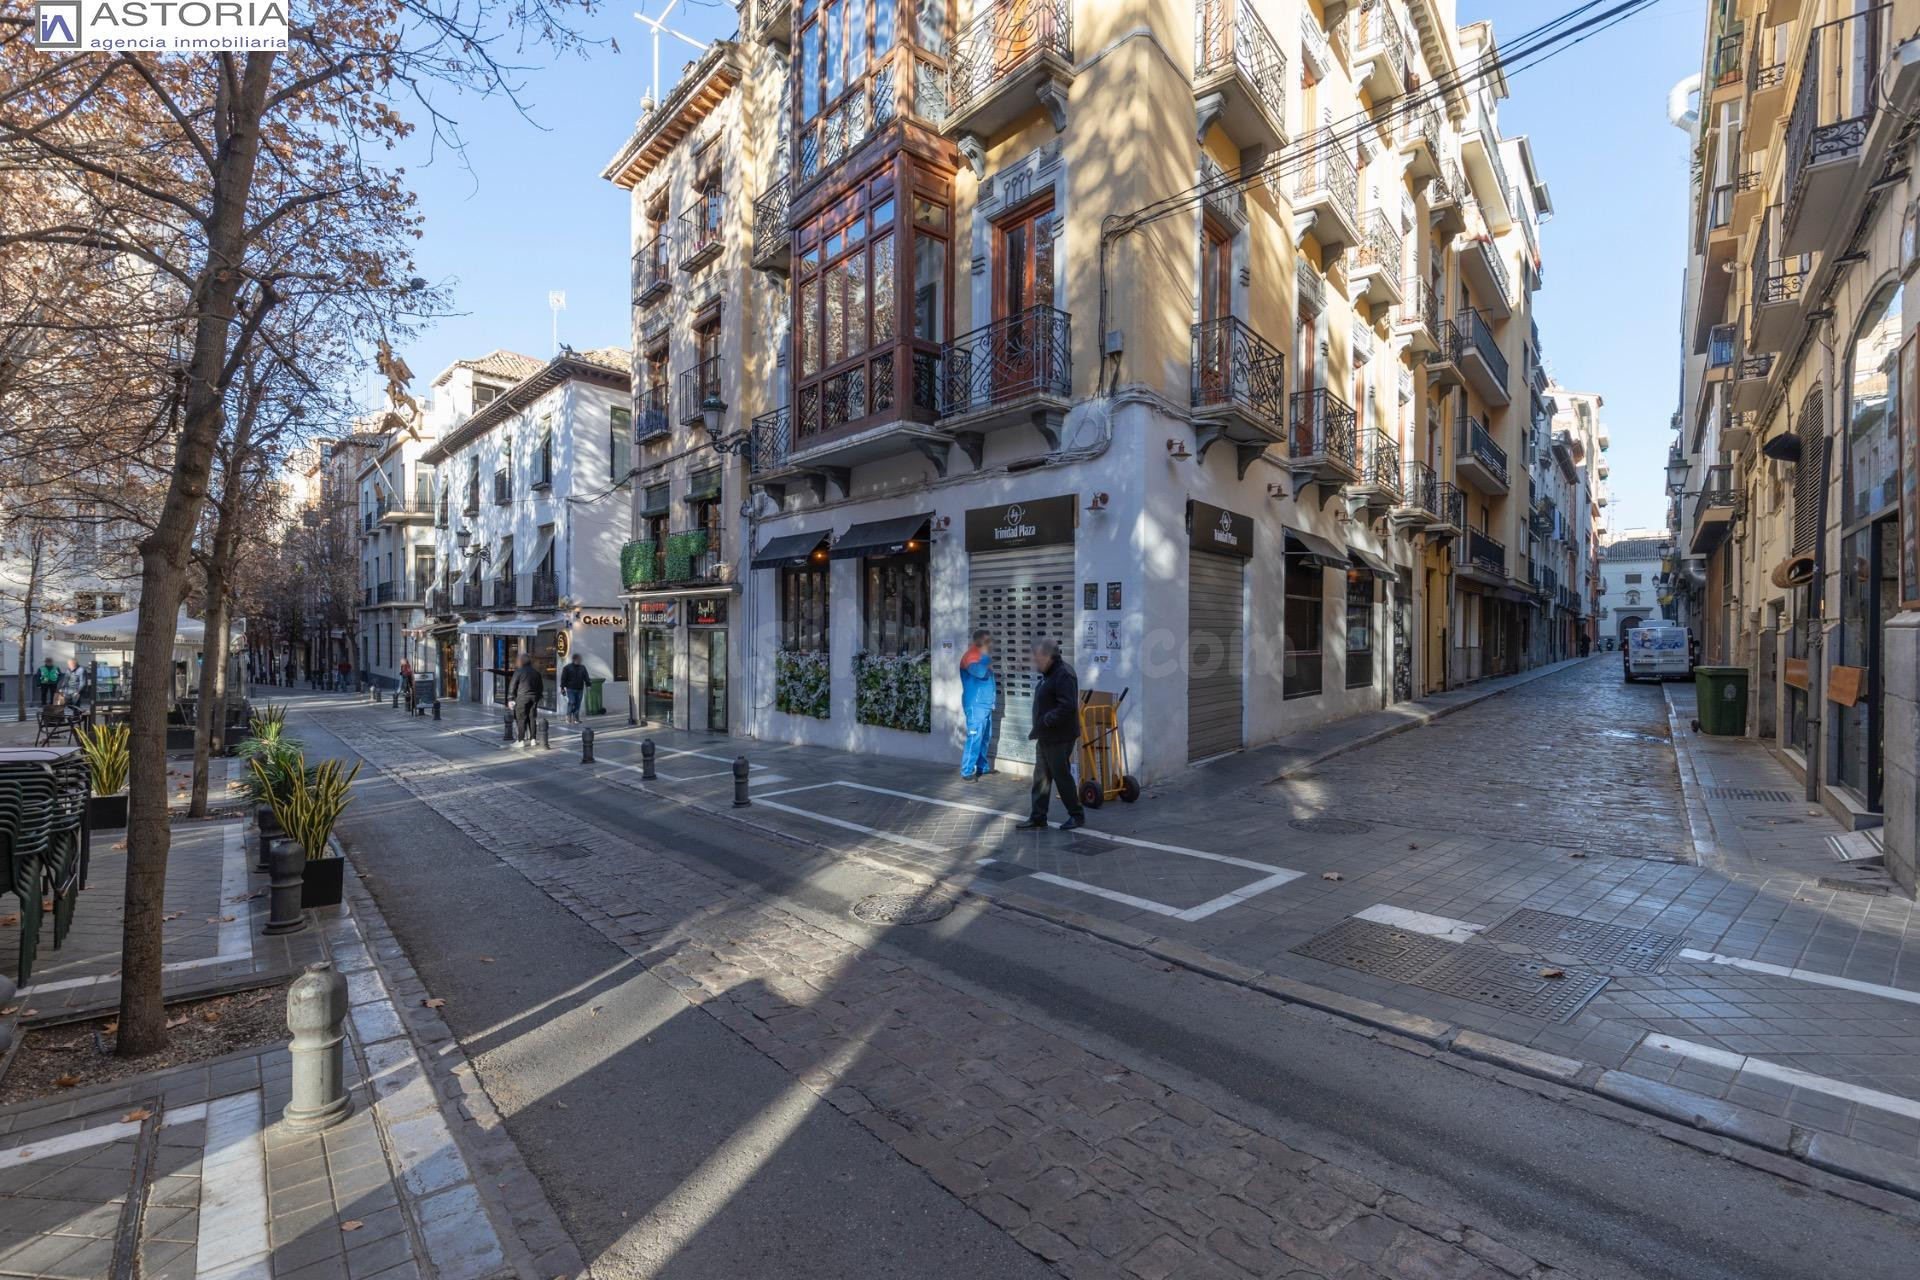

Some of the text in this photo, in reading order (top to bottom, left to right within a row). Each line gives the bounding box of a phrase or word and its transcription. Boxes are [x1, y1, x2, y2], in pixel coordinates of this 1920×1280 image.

[994, 524, 1036, 540] Trinidad Plaza
[583, 615, 610, 625] Café
